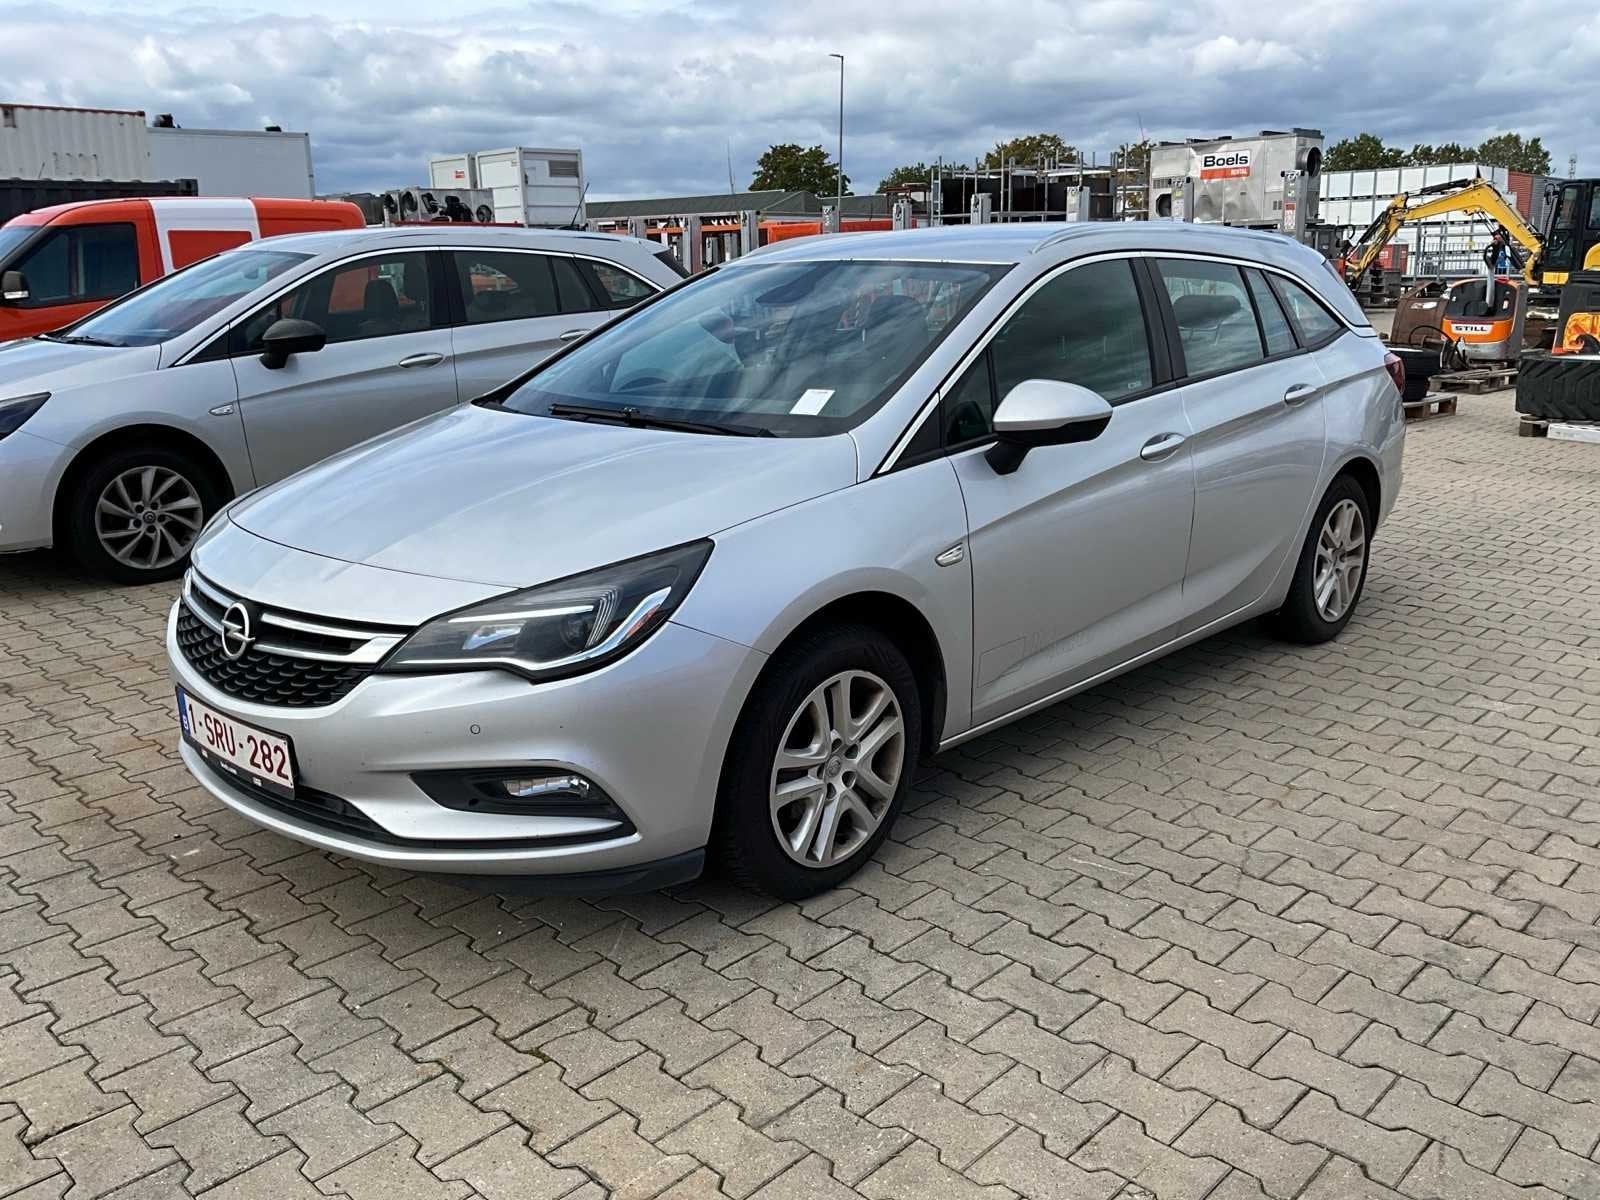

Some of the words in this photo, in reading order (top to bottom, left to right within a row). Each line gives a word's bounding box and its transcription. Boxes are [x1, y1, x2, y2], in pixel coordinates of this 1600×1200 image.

[1203, 153, 1249, 168] Boels
[182, 714, 190, 730] B
[188, 703, 289, 780] 1-SRU-282
